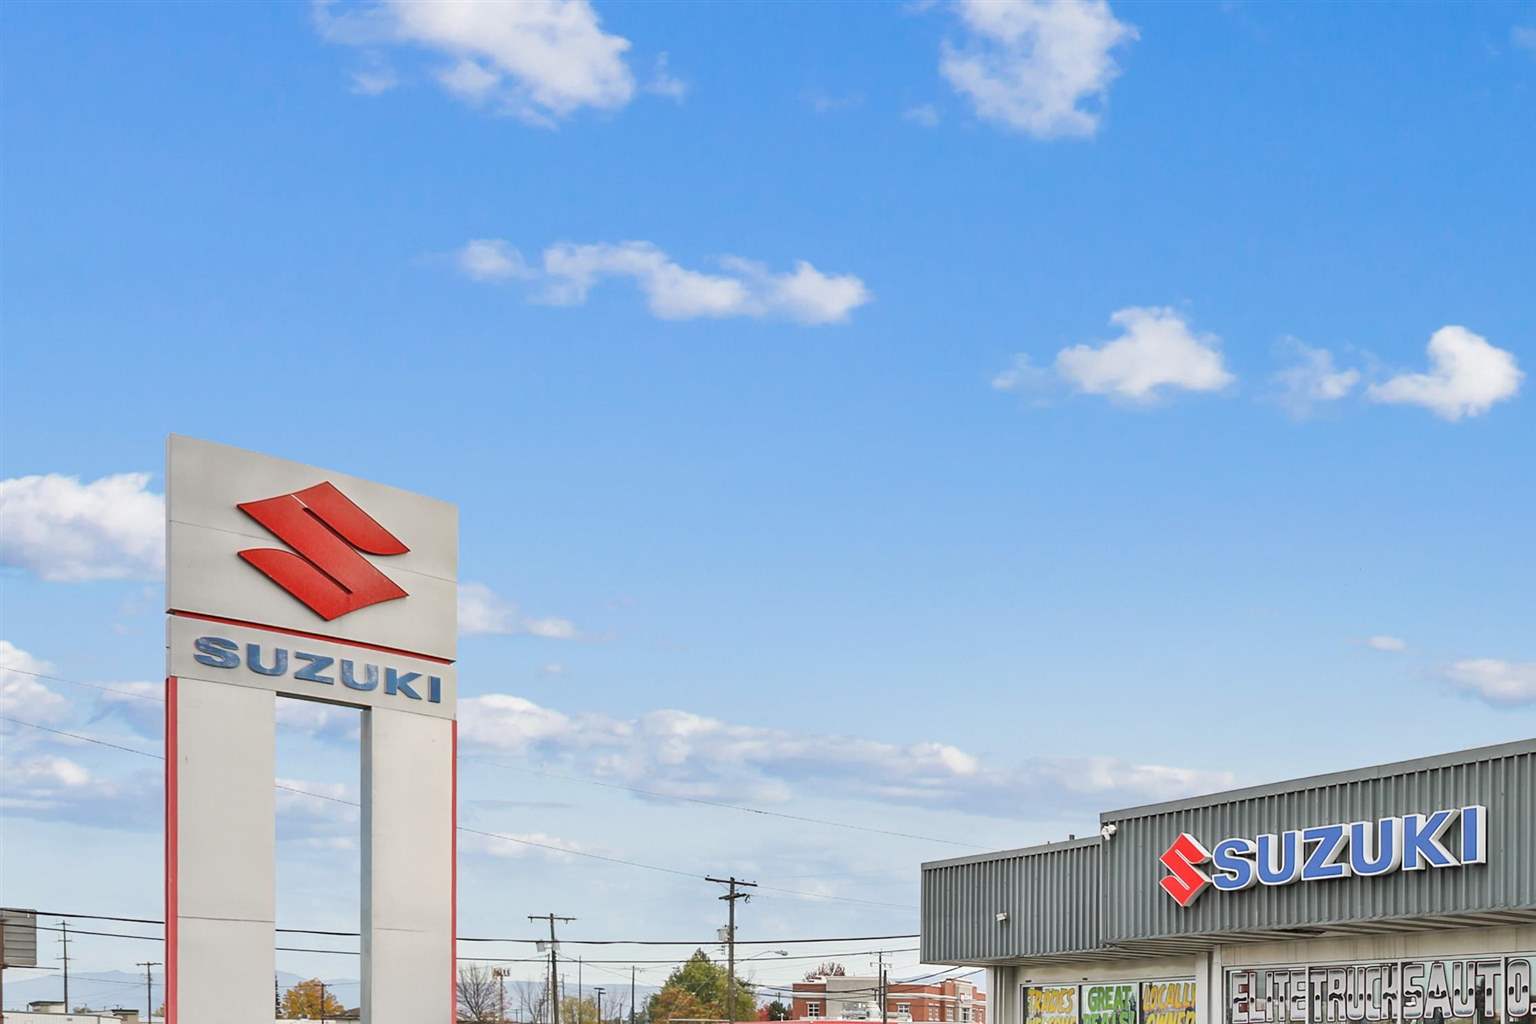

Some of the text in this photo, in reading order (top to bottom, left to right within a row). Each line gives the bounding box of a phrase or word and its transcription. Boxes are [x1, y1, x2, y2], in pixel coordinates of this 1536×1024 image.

[193, 636, 441, 703] SUZUKI
[1212, 805, 1486, 891] SUZUKI
[1088, 985, 1132, 1012] GREAT
